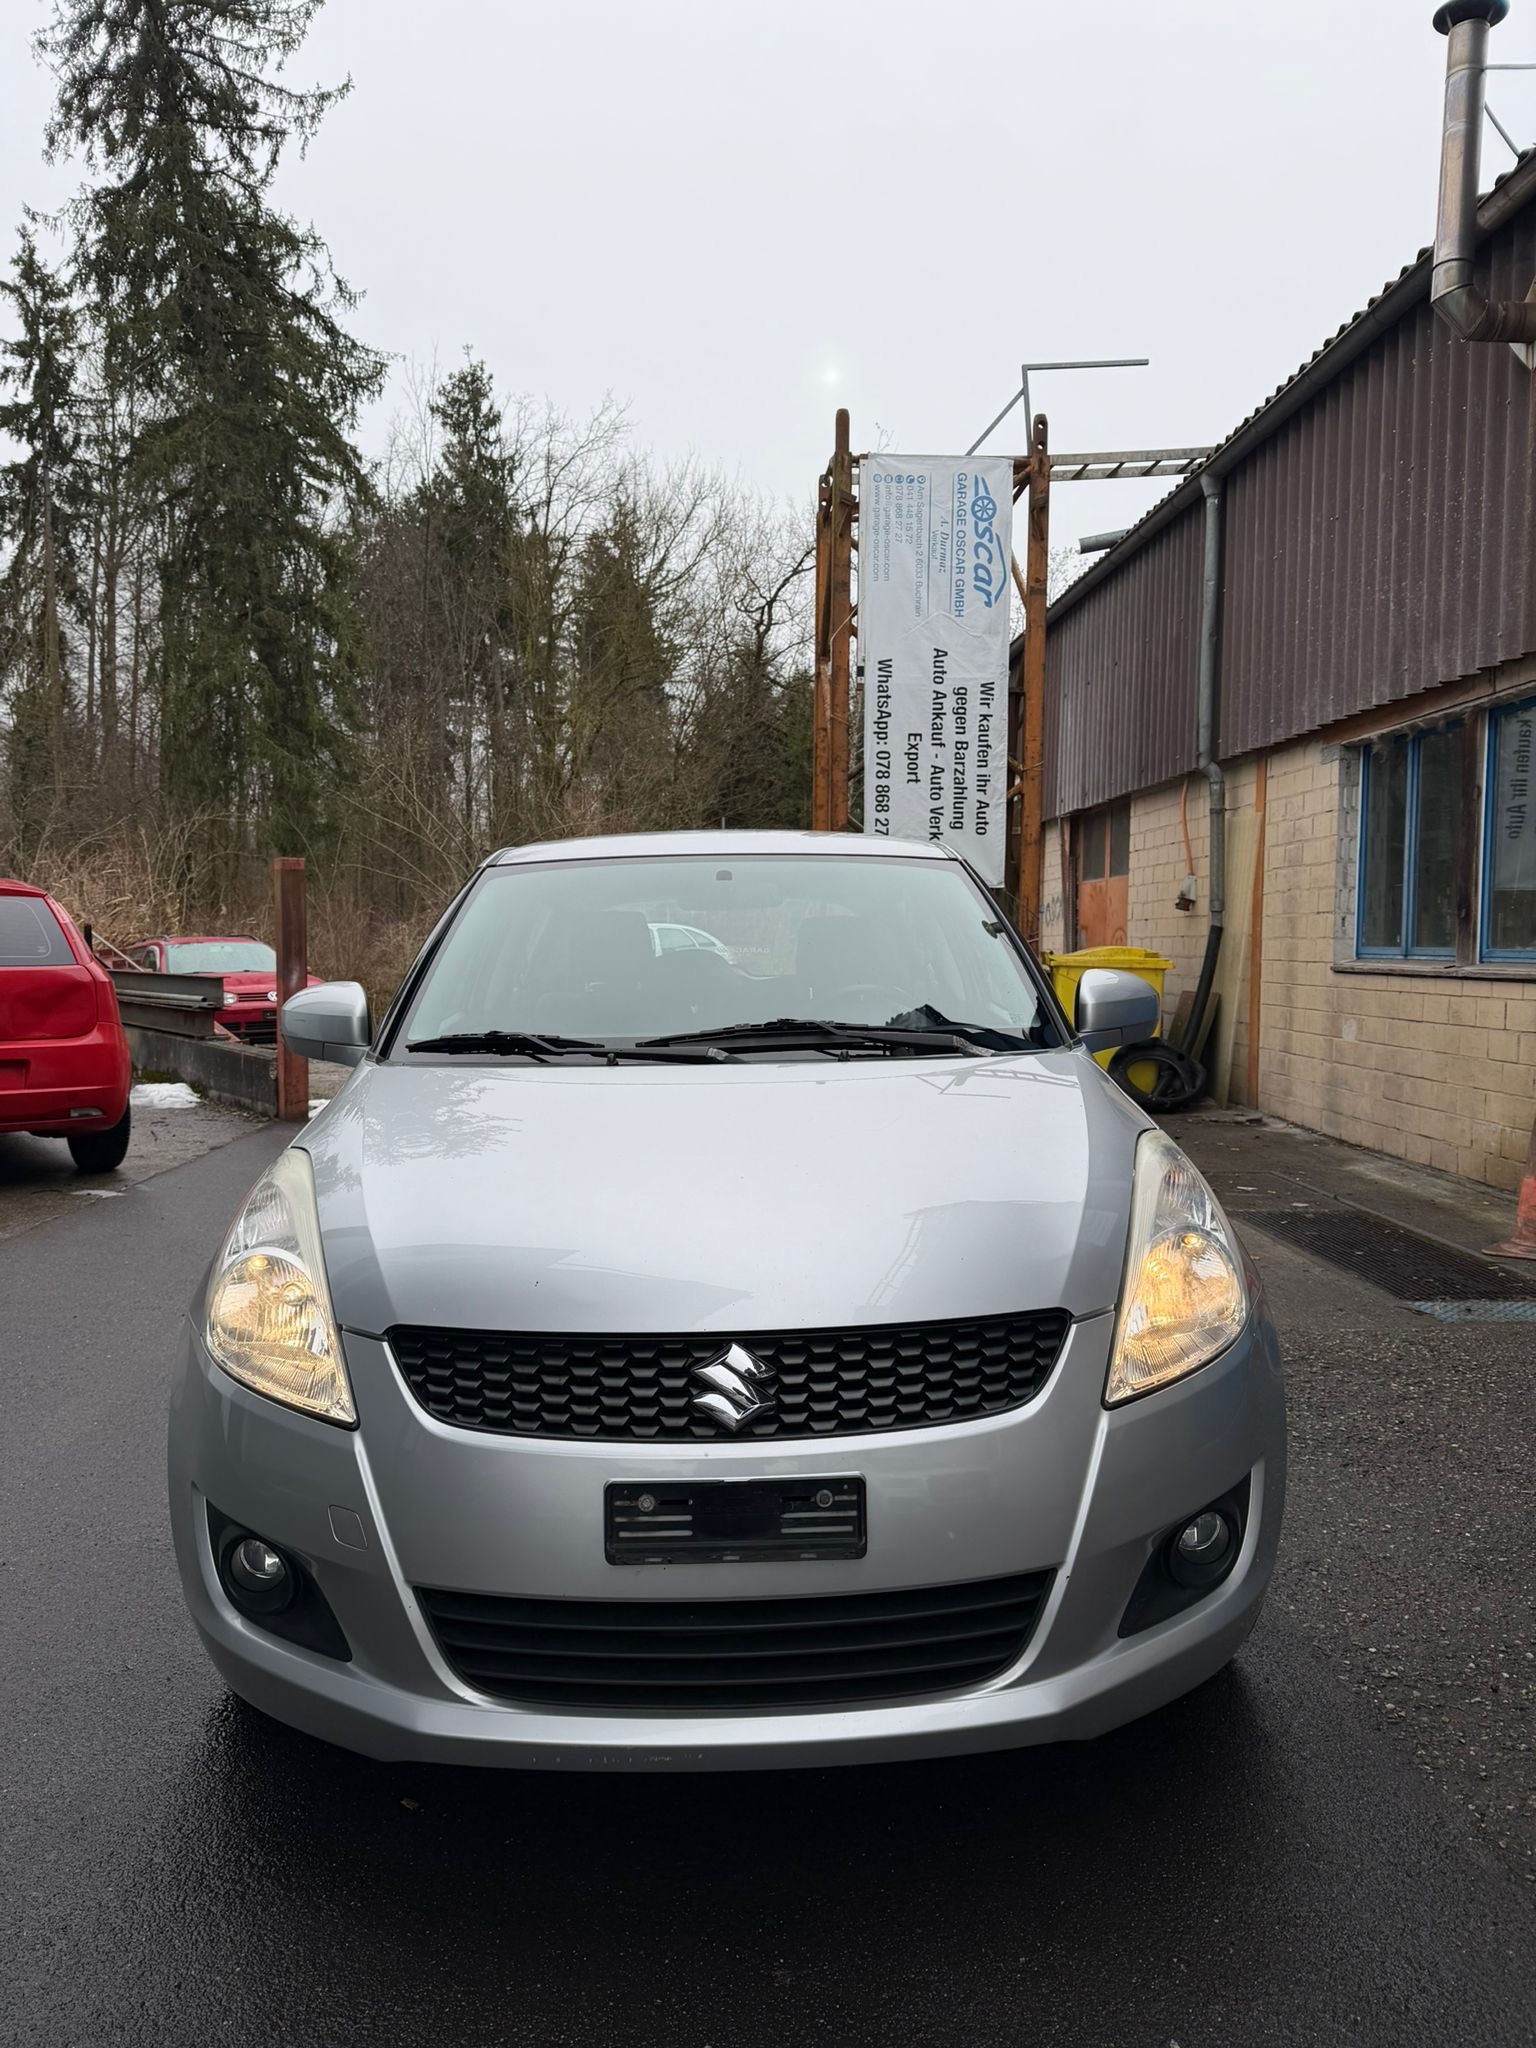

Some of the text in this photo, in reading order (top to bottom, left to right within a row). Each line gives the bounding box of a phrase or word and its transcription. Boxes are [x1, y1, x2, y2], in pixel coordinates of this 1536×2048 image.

[895, 503, 903, 518] 868
[906, 486, 914, 500] 041
[917, 486, 924, 500] Am
[872, 485, 880, 582] www.garage-oscar.com
[895, 520, 902, 531] 27
[895, 533, 902, 544] 27
[906, 522, 913, 532] 15
[906, 534, 913, 544] 72
[955, 473, 967, 618] GARAGE OSCAR GMBH
[915, 558, 923, 579] 6033
[933, 648, 948, 684] Auto
[931, 690, 947, 748] Ankauf
[873, 659, 892, 836] WhatsApp: 078 868 27
[905, 733, 922, 784] Export
[949, 686, 969, 830] gegen Barzahlung
[976, 682, 995, 835] Wir kaufen ihr Auto
[930, 765, 945, 800] Auto
